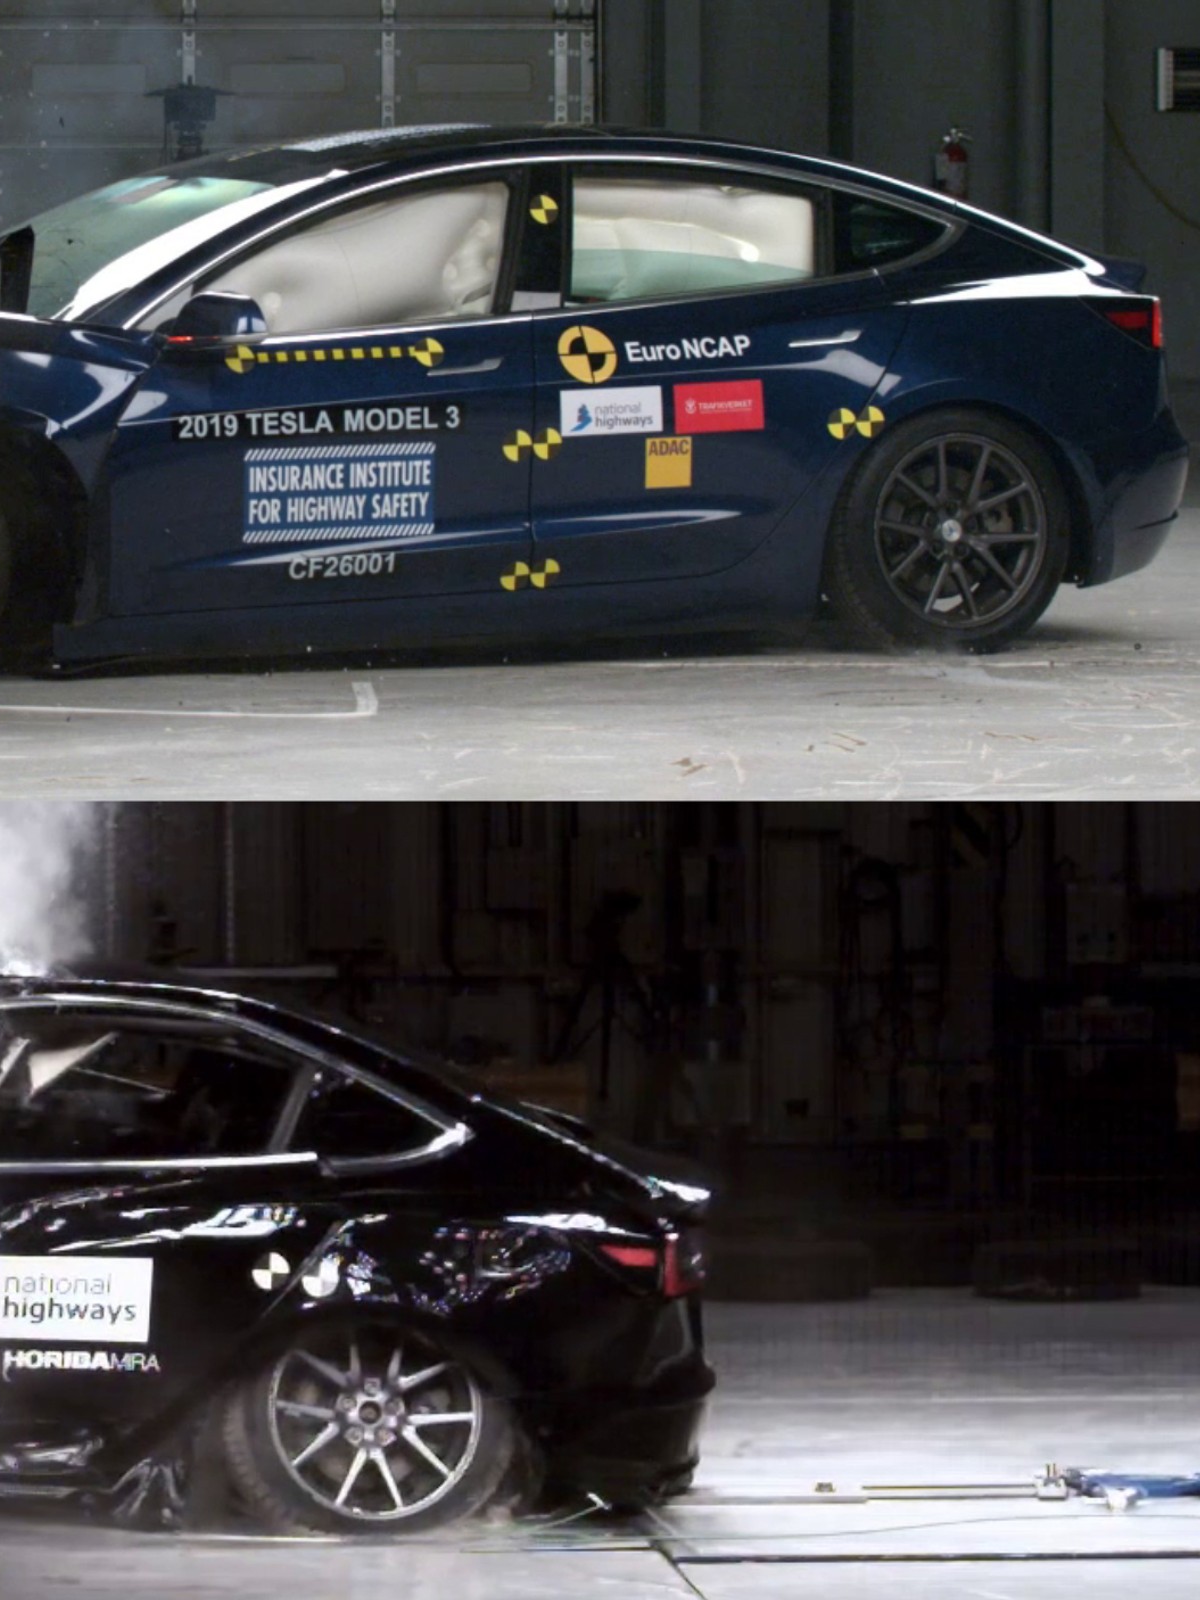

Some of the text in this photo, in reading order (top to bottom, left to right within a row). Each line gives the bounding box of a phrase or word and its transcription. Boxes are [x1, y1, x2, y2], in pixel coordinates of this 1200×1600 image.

[624, 335, 750, 362] Euro NCAP
[178, 405, 460, 438] 2019 TESLA MODEL 3
[594, 402, 642, 415] national
[594, 415, 653, 430] highways
[648, 440, 690, 456] ADAC
[248, 459, 432, 493] INSURANCE INSTITUTE
[247, 491, 430, 525] FOR HIGHWAY SAFETY
[288, 552, 397, 580] CF26001
[3, 1273, 112, 1296] national
[3, 1296, 137, 1325] highways
